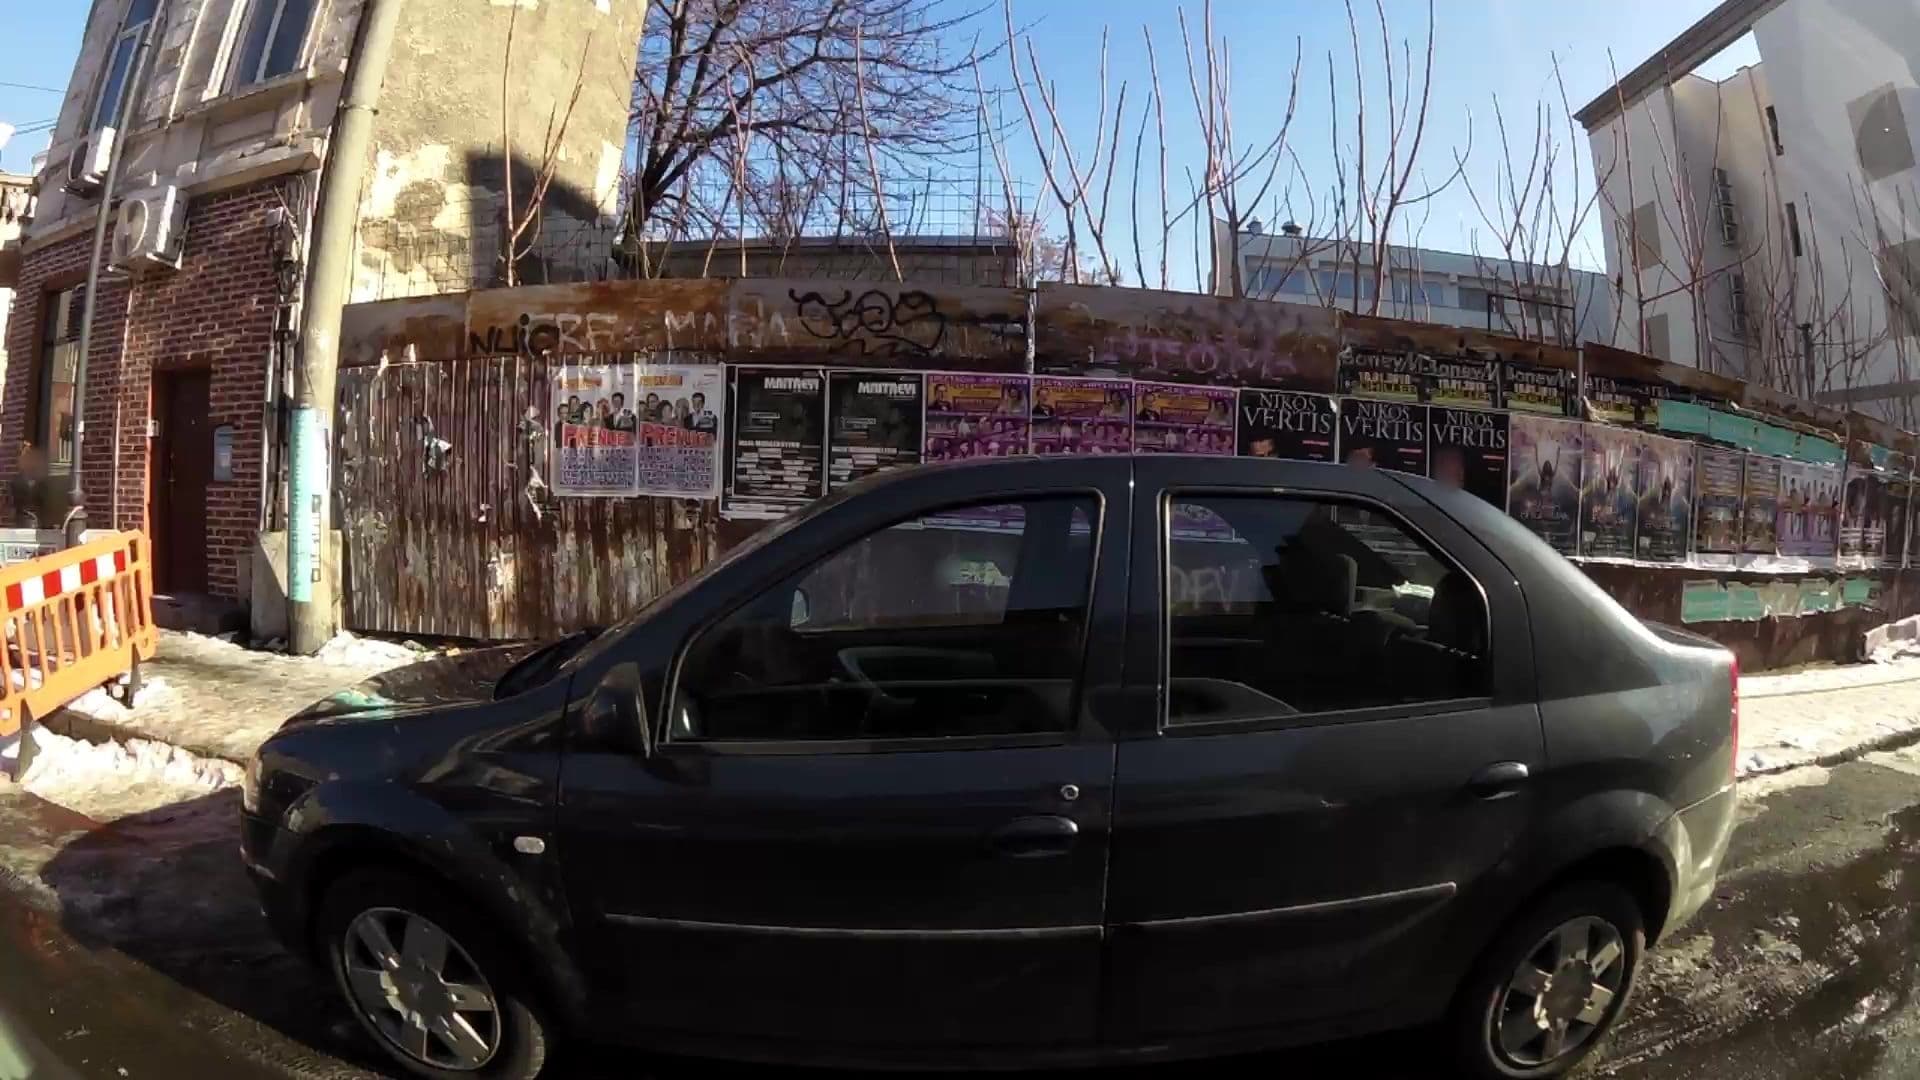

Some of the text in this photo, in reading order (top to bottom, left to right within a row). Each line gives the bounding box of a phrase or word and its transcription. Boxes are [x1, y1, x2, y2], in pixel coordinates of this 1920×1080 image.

[1259, 392, 1318, 412] NIKOS
[1357, 402, 1411, 421] NIKOS
[1243, 407, 1332, 434] VERTIS
[1344, 415, 1424, 441] VERTIS
[1446, 410, 1494, 428] NIKOS
[1432, 422, 1506, 449] VERTIS
